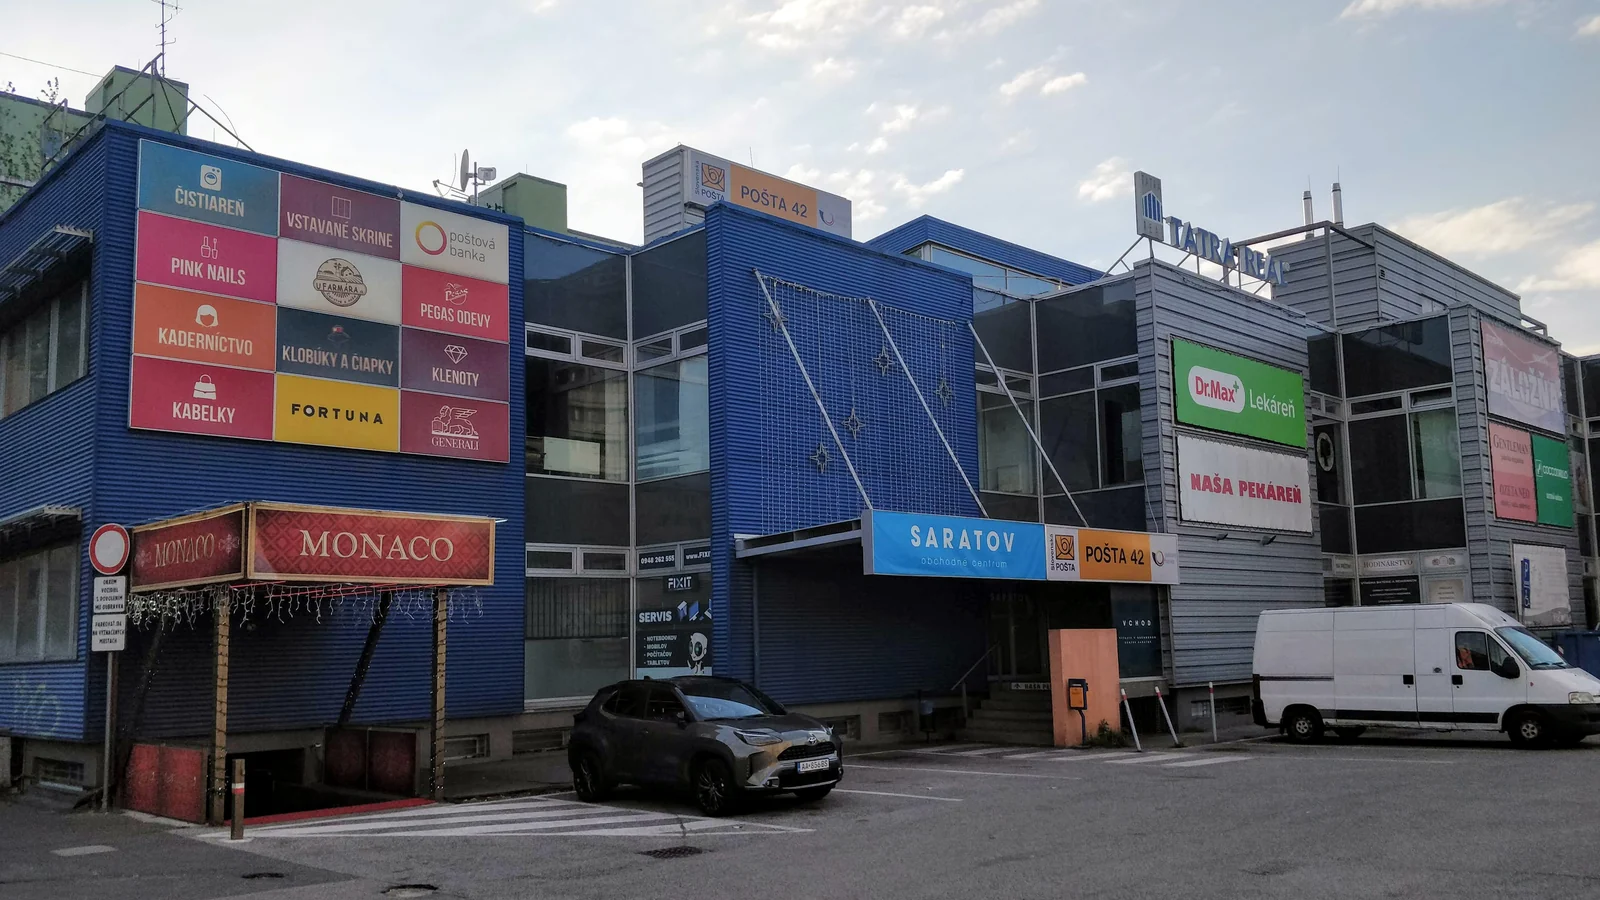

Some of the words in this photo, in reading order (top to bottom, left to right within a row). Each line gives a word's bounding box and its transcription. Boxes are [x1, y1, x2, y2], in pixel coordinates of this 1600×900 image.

[174, 184, 245, 217] ČISTIAREŇ
[701, 188, 725, 200] POŠTA
[741, 185, 788, 212] POŠTA
[791, 204, 808, 219] 42
[286, 211, 349, 240] VSTAVANÉ
[352, 226, 394, 249] SKRINE
[449, 231, 496, 250] poštová
[449, 244, 486, 262] banka
[1166, 215, 1236, 269] TATRA
[171, 257, 203, 279] PINK
[207, 263, 246, 286] NAILS
[315, 282, 321, 290] U
[322, 282, 359, 293] FARMÁRA
[420, 303, 455, 322] PEGAS
[457, 309, 491, 328] ODEVY
[158, 326, 253, 357] KADERNÍCTVO
[282, 344, 339, 370] KLOBÚKY
[340, 353, 349, 370] A
[351, 351, 394, 376] ČIAPKY
[432, 367, 480, 387] KLENOTY
[1195, 375, 1235, 403] Dr.Max
[1249, 388, 1296, 419] Lekáreň
[172, 401, 236, 425] KABELKY
[291, 403, 384, 425] FORTUNA
[431, 436, 480, 451] GENERALI
[1493, 434, 1529, 455] GENTLEMAN
[1190, 472, 1234, 496] NAŠA
[1238, 480, 1302, 504] PEKÁREŇ
[299, 528, 455, 562] MONACO
[910, 524, 1016, 553] SARATOV
[153, 532, 216, 568] MONACO
[665, 554, 675, 562] 555
[1085, 542, 1127, 565] POŠTA
[1130, 549, 1145, 565] 42
[920, 555, 968, 568] obchodné
[971, 558, 1009, 569] centrum
[1056, 562, 1076, 572] POŠTA
[1363, 558, 1414, 569] HODINÁRSTVO
[668, 576, 692, 589] FIXIT
[639, 611, 672, 622] SERVIS
[1122, 619, 1152, 627] VCHOD
